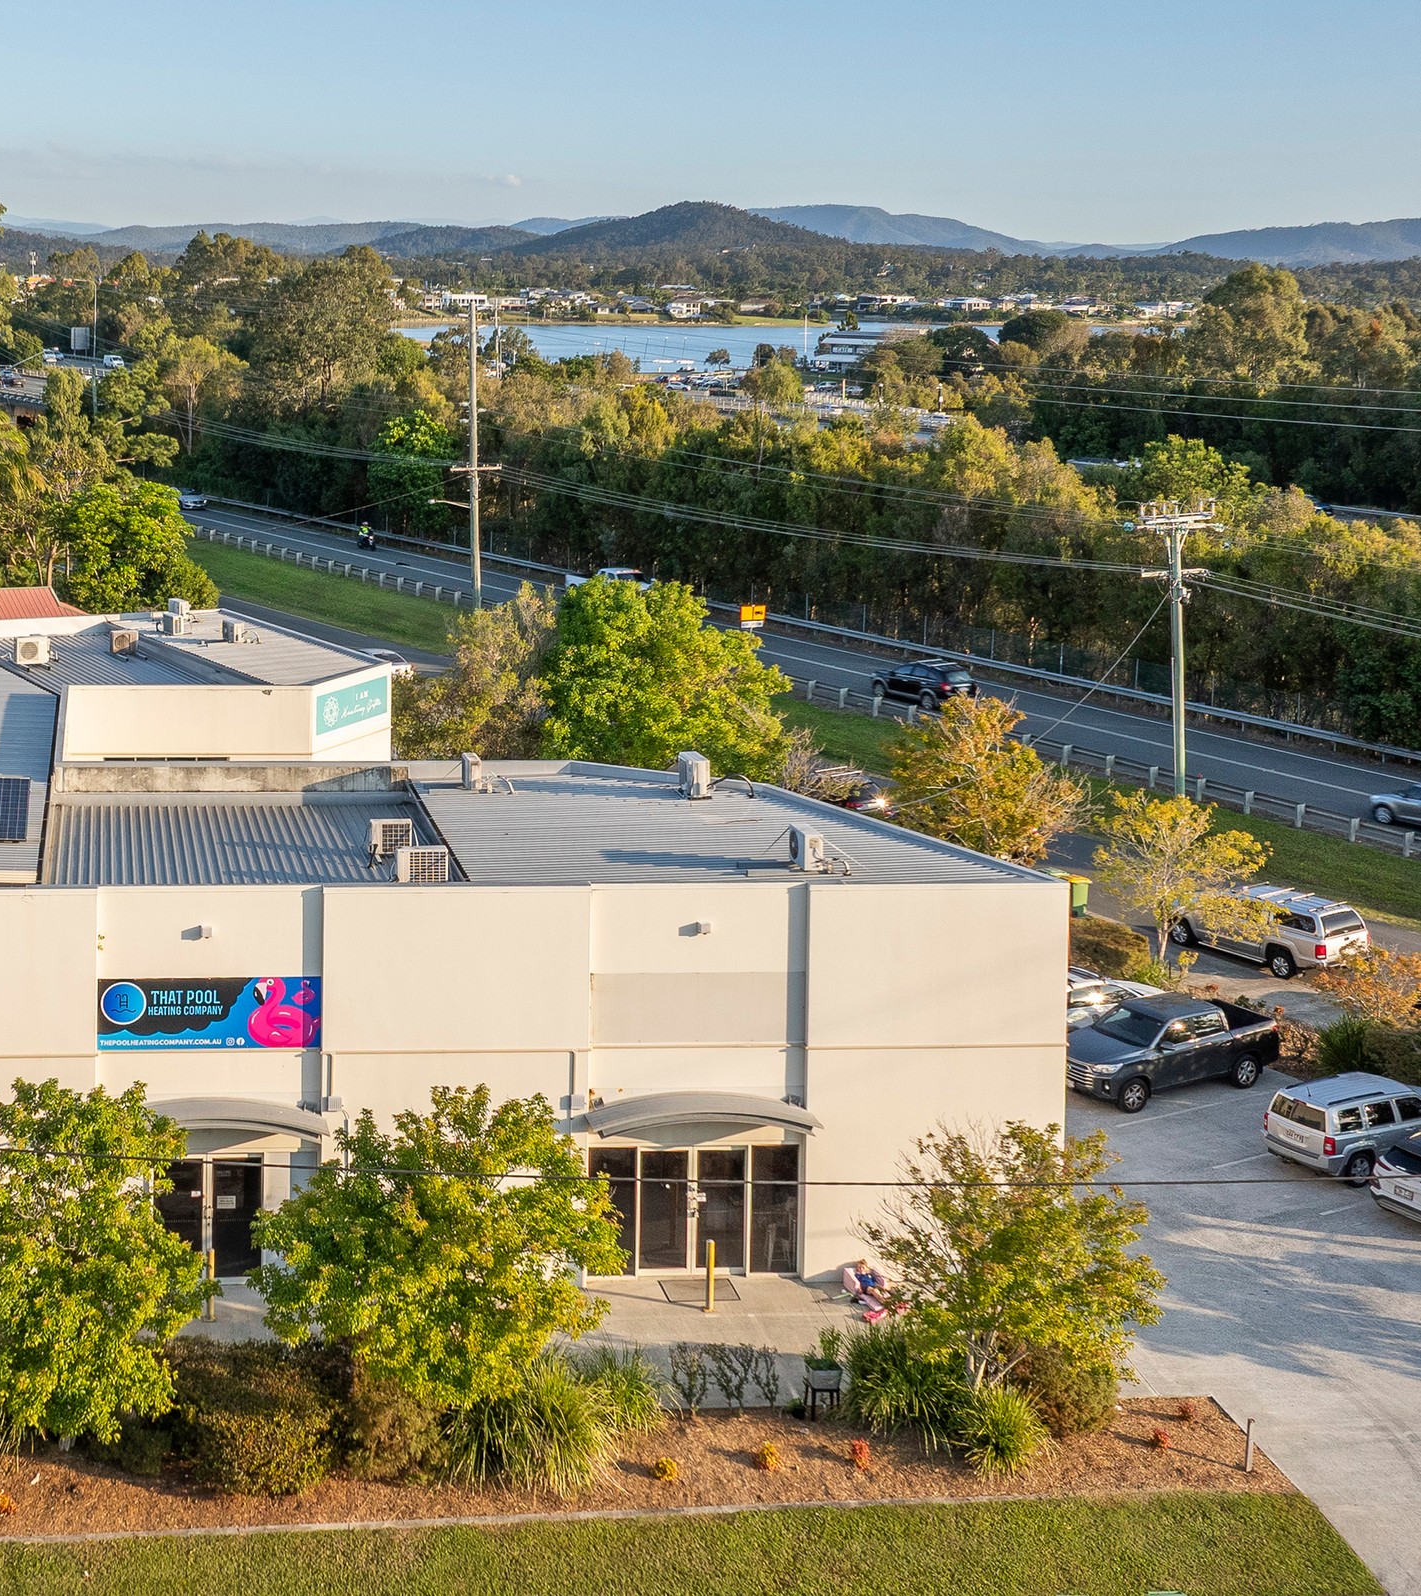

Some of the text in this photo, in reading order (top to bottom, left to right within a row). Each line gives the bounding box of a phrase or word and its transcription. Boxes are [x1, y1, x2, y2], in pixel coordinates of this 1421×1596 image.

[360, 690, 369, 699] AM
[151, 989, 221, 1005] THAT POOL
[148, 1005, 224, 1016] HEATING COMPANY
[99, 1038, 222, 1047] THEPOOLHEATINGCOMPANY.COM.AU
